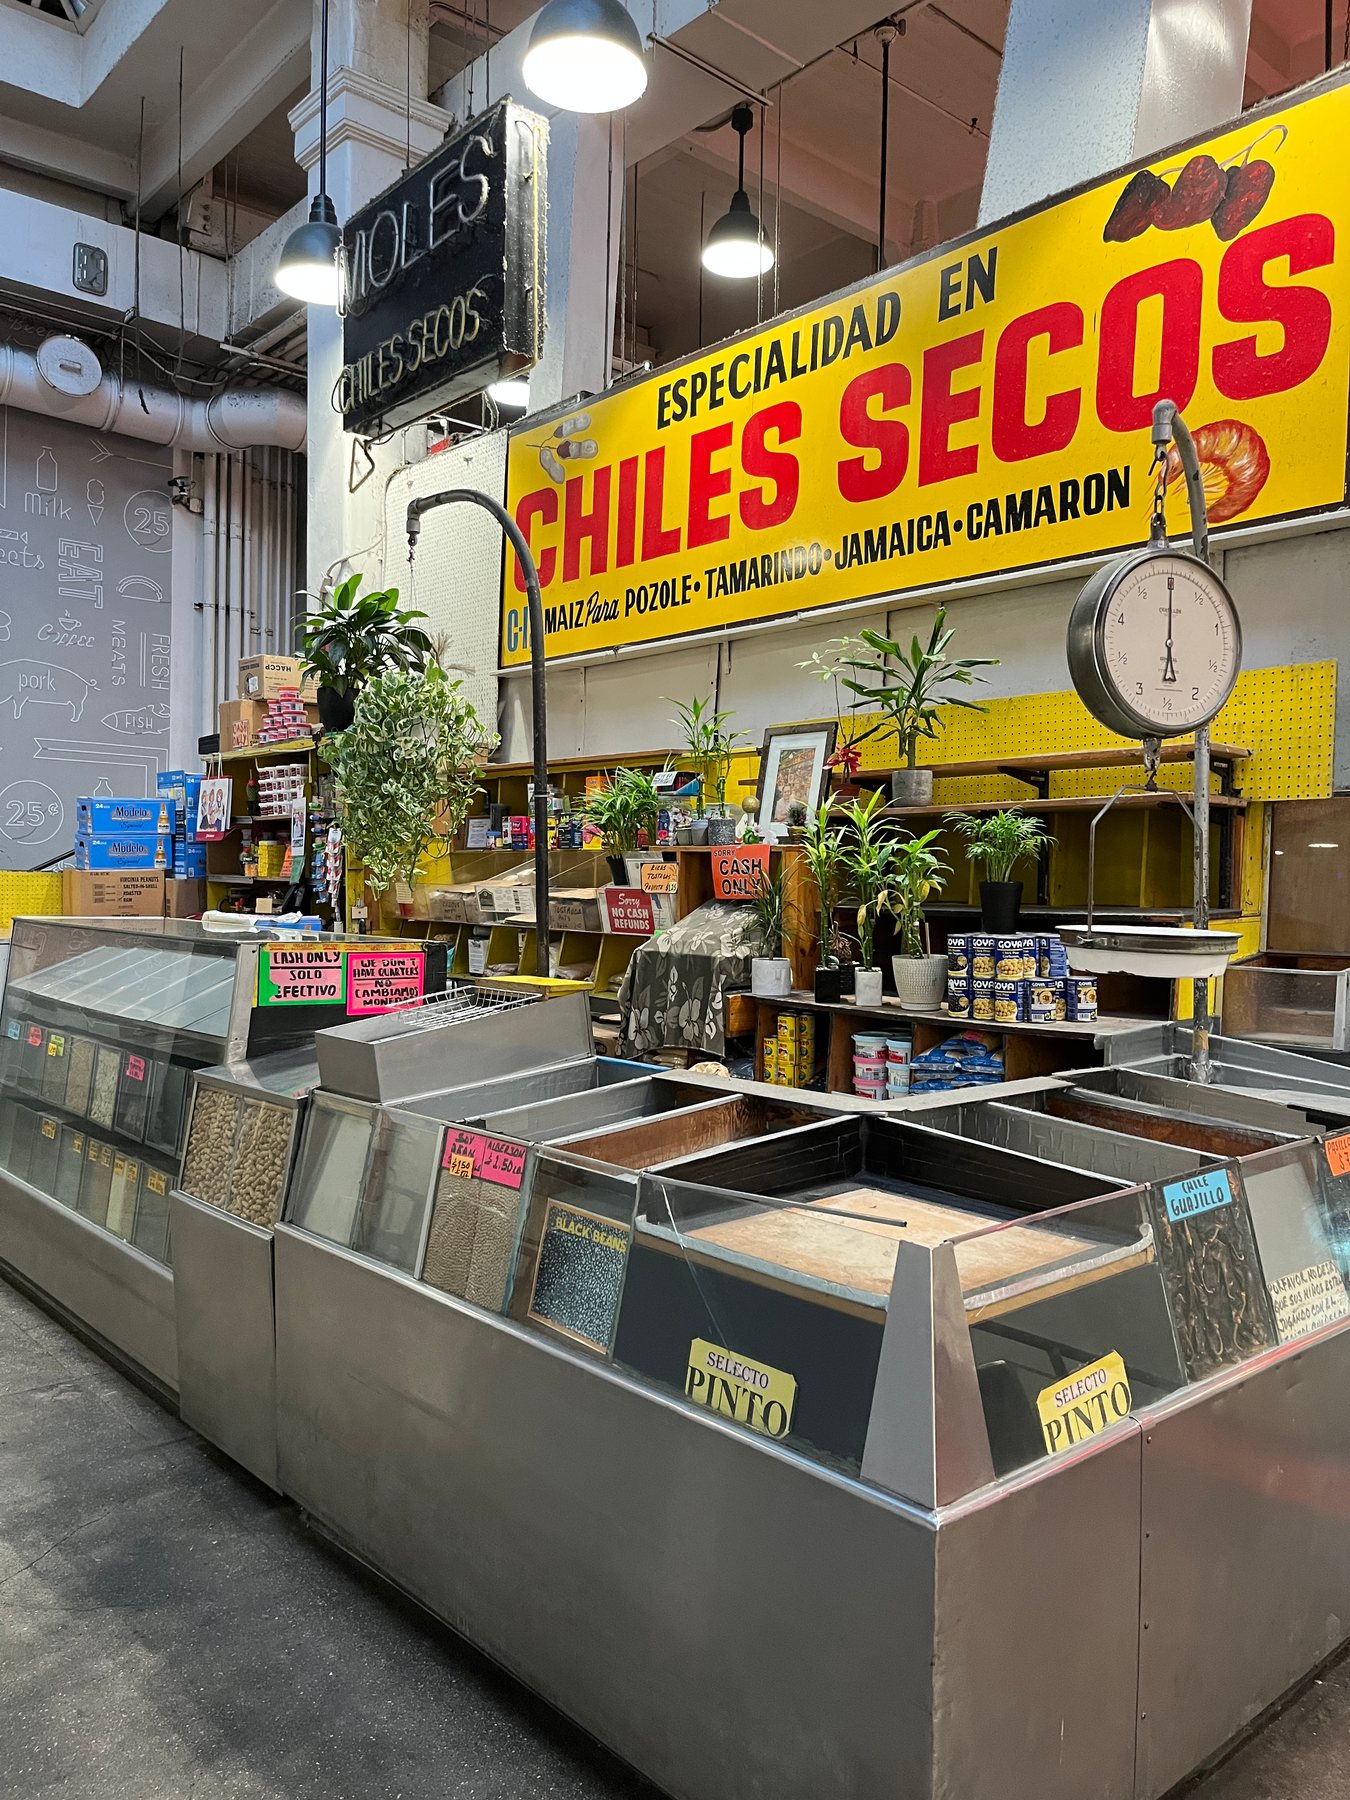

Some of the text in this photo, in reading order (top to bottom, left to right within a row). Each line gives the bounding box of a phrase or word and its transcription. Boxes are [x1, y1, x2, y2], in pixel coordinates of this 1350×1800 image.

[937, 245, 999, 322] EN
[333, 288, 488, 414] CHILES SECOS
[655, 290, 903, 430] ESPECIALIDAD
[513, 212, 1336, 595] CHILES SECOS
[25, 491, 72, 521] milk
[133, 507, 170, 537] 25
[544, 599, 585, 635] MAIZ
[584, 591, 620, 627] Para
[966, 465, 1131, 541] CAMARON
[58, 537, 104, 609] EAT
[1117, 612, 1125, 626] 4
[1214, 623, 1220, 636] 1
[111, 619, 126, 687] MEATS
[151, 633, 171, 691] FRESH
[265, 664, 292, 672] HACCP
[18, 669, 56, 692] pork
[1135, 682, 1144, 696] 3
[1191, 687, 1200, 701] 2
[125, 713, 153, 729] FISH
[115, 806, 148, 817] Modelo
[112, 842, 144, 853] Modelo
[719, 858, 762, 876] CASH
[618, 892, 640, 908] Sorry
[611, 907, 649, 919] NO CASH
[614, 918, 650, 930] REFUNDS
[998, 940, 1023, 949] GOYA
[273, 951, 341, 965] CASH ONLY
[360, 959, 377, 967] WE
[289, 969, 323, 981] SOLO
[353, 966, 419, 978] HAVE QUARTERS
[355, 986, 419, 998] CAMBIAMOS
[374, 979, 393, 988] NO
[1181, 1175, 1209, 1194] CHILE
[1170, 1186, 1225, 1217] GUAJILLO
[555, 1216, 628, 1253] BLACK BEANS
[705, 1350, 770, 1390] SELECTO
[1054, 1367, 1109, 1408] SELECTO
[687, 1364, 788, 1438] PINTO
[1043, 1380, 1132, 1454] PINTO
